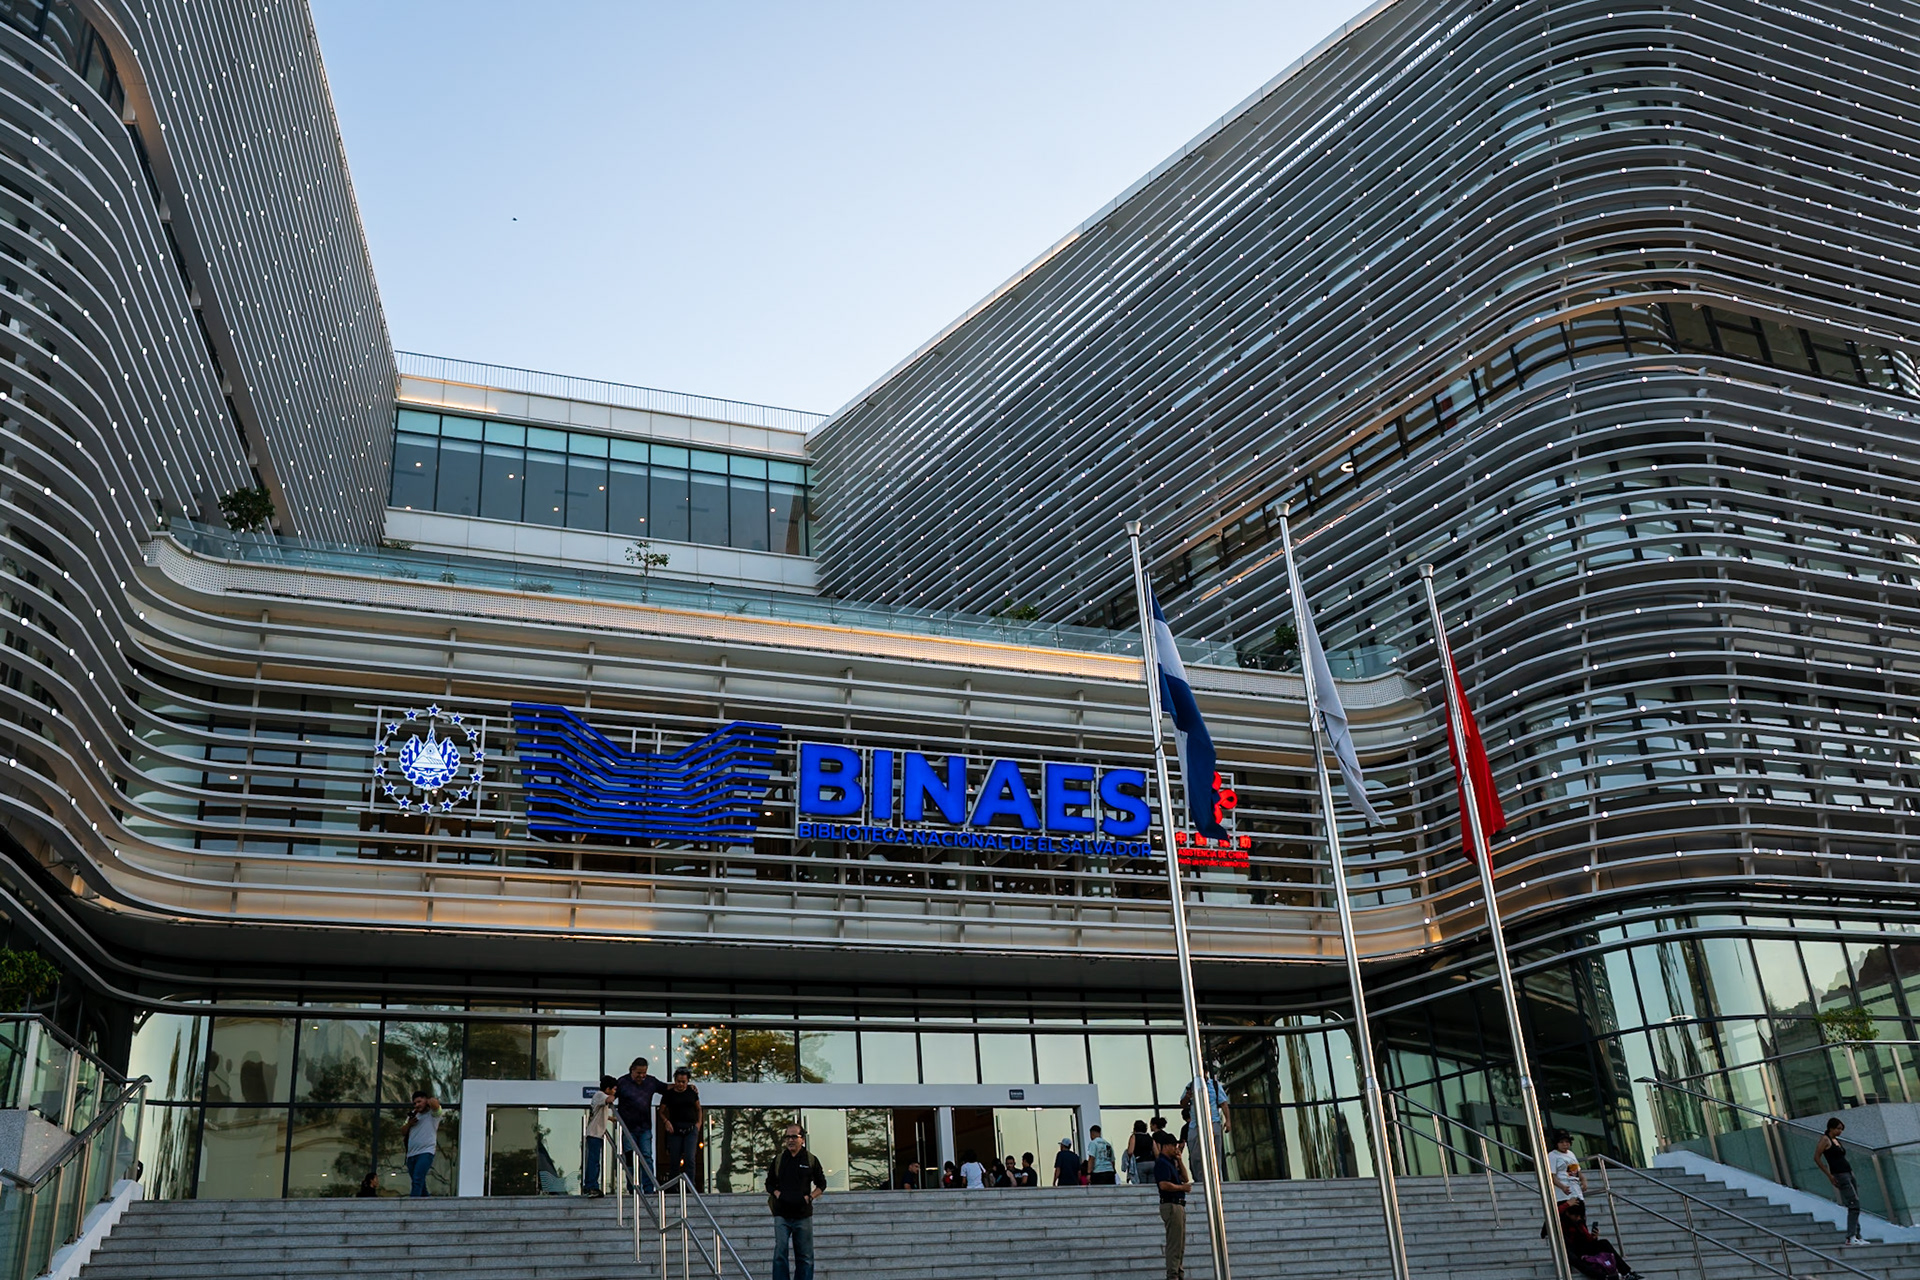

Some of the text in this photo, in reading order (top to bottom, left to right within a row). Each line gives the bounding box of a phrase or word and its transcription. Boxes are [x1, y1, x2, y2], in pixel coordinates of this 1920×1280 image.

[799, 742, 1152, 838] BINAES
[798, 822, 1152, 858] BIBLIOTECA NACIONAL DE EL SALVADOR
[1177, 848, 1249, 860] ASISTENCIA DE CHINA
